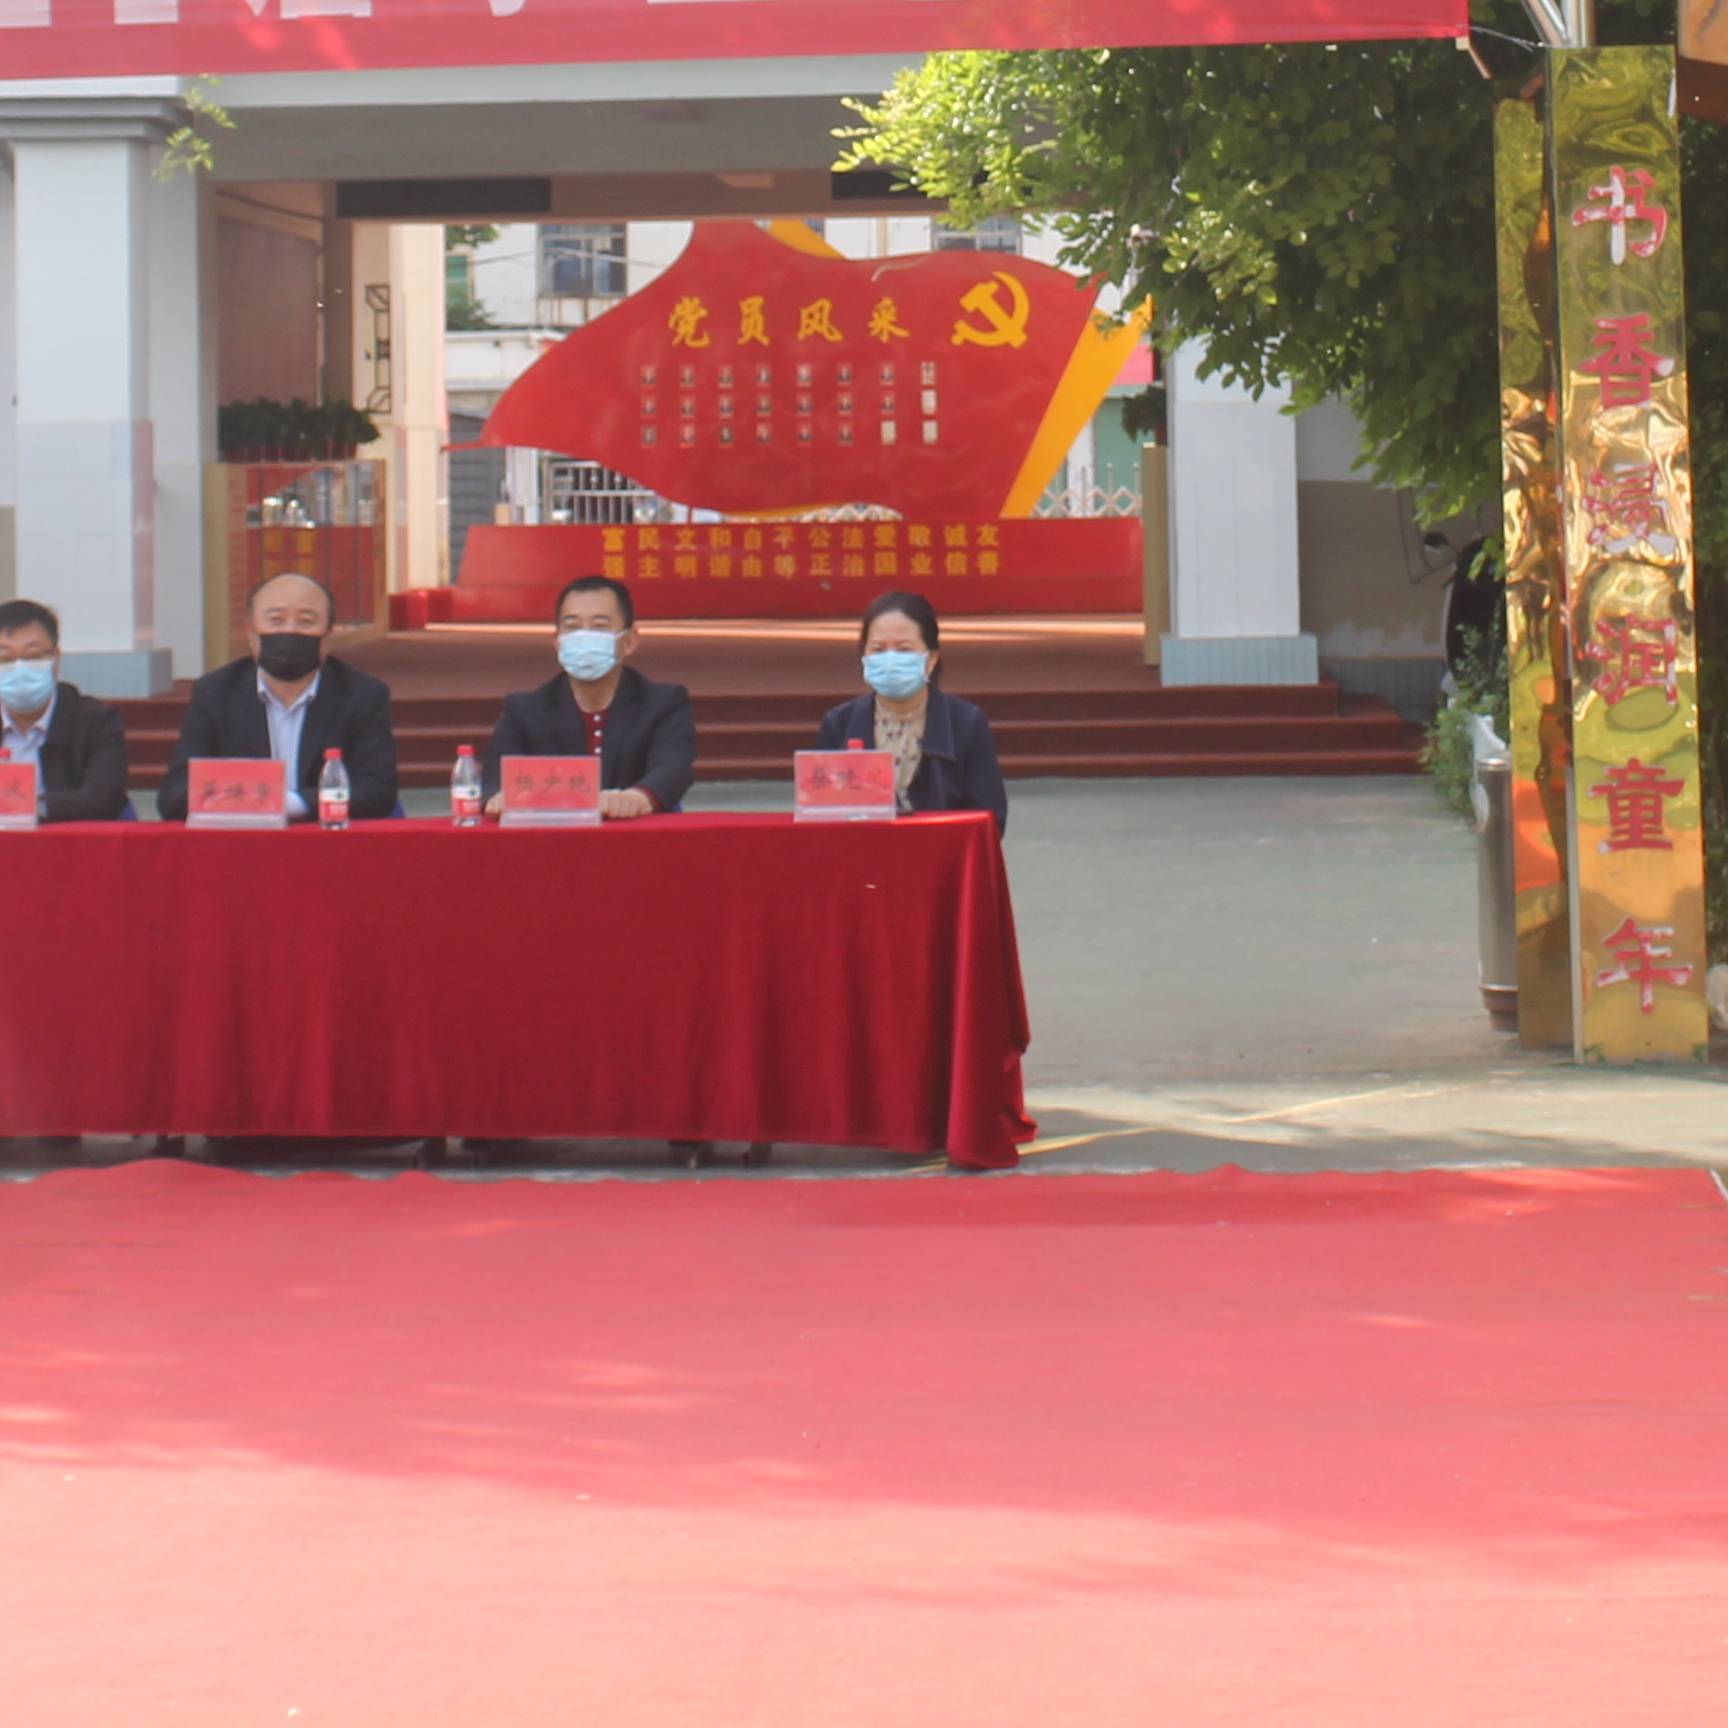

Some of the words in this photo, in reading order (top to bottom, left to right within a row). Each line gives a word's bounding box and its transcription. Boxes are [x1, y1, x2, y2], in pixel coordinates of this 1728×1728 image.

[667, 296, 911, 349] 党员风采
[1572, 164, 1694, 1014] 书香浸润童年
